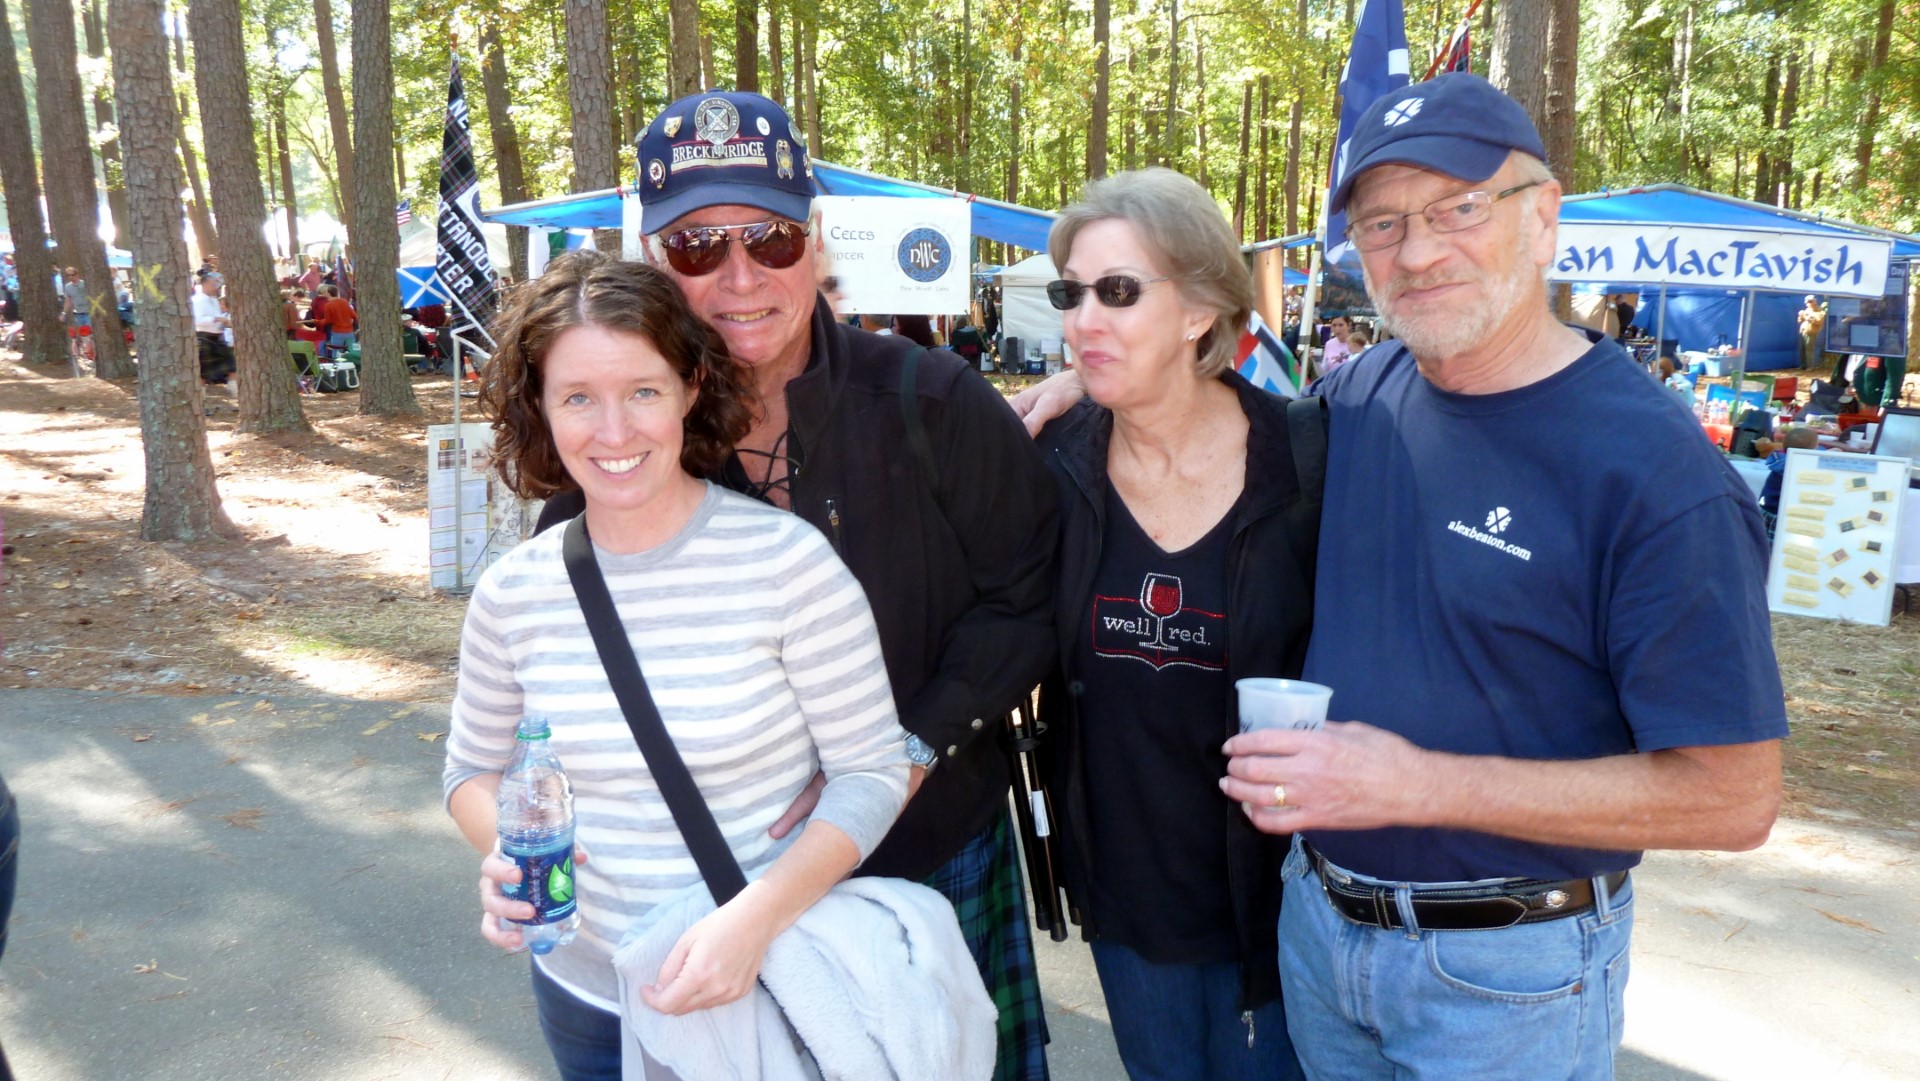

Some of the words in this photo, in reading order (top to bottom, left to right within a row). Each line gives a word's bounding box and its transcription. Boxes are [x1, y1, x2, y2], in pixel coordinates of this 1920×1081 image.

[449, 99, 471, 135] NE
[438, 194, 493, 283] TTANOO
[1633, 235, 1864, 286] MacTavish
[1891, 266, 1906, 277] Day
[1447, 520, 1532, 561] alexbeaton.com
[1103, 616, 1151, 636] well
[1168, 626, 1211, 646] red.
